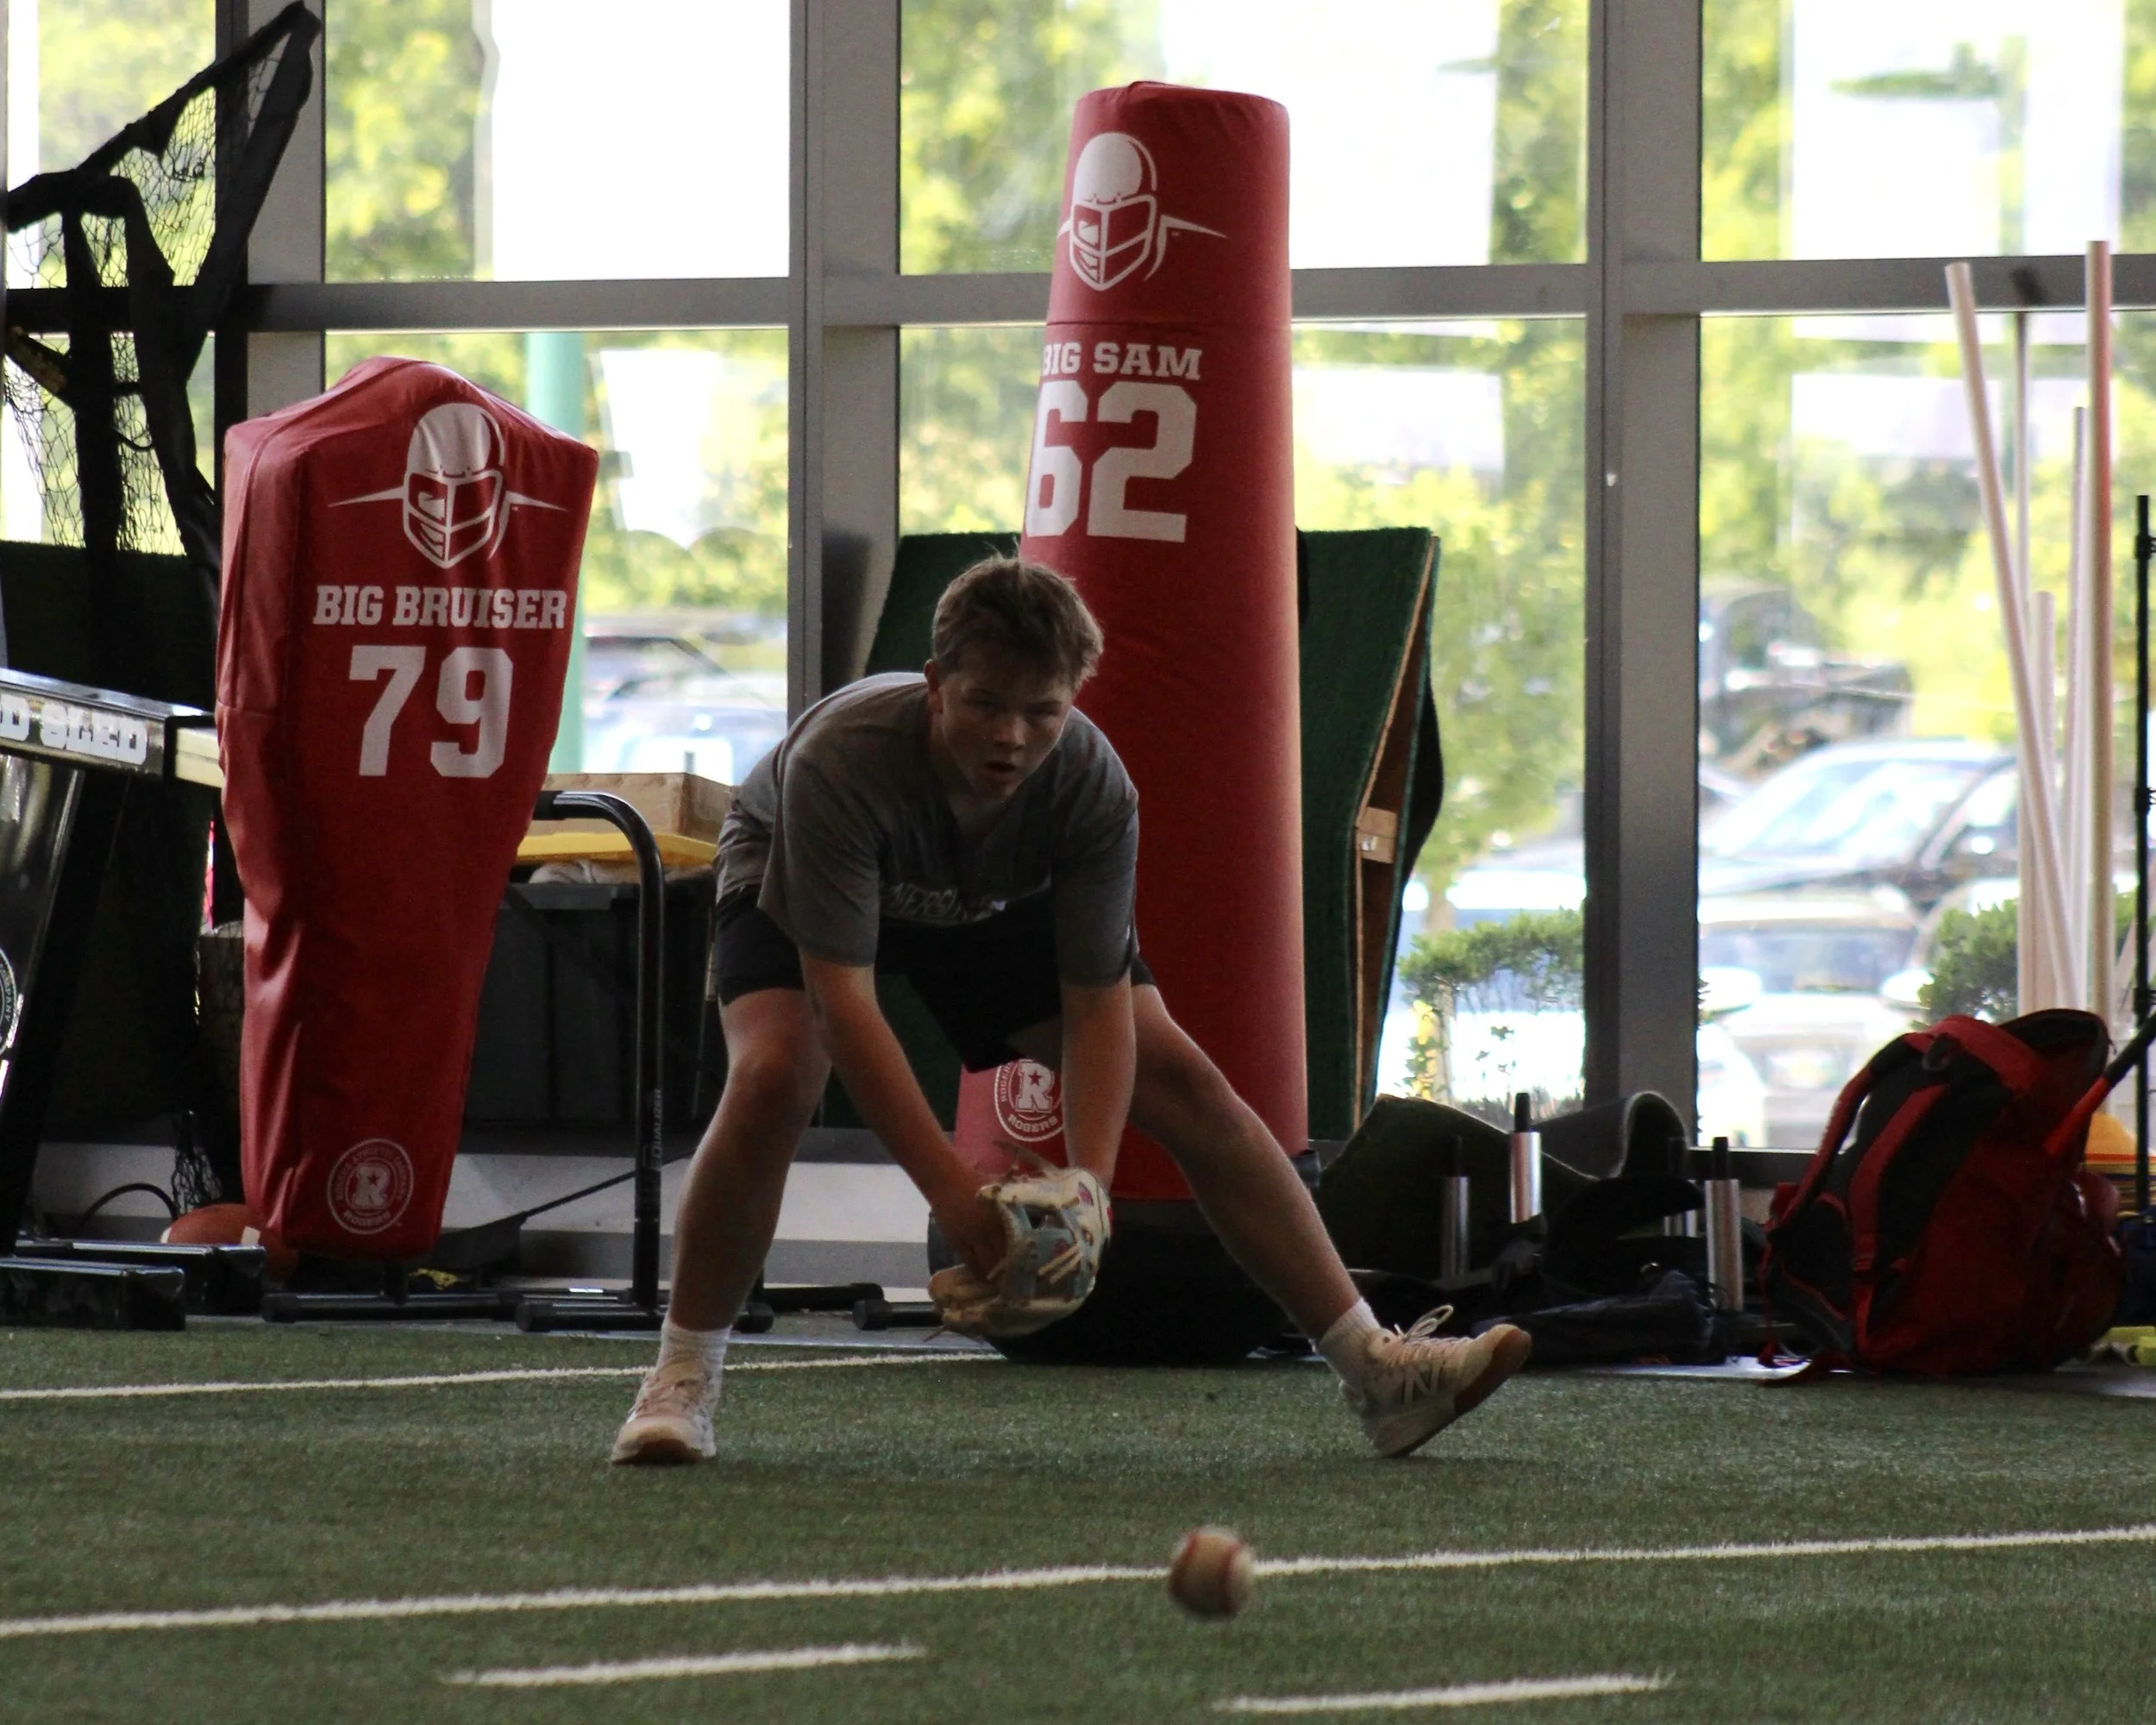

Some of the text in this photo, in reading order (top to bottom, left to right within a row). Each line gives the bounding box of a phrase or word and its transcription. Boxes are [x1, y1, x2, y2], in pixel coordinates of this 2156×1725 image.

[1042, 342, 1203, 380] BIG SAM
[1025, 380, 1198, 543] 62
[313, 585, 567, 629] BIG BRUISER
[348, 644, 514, 778] 79
